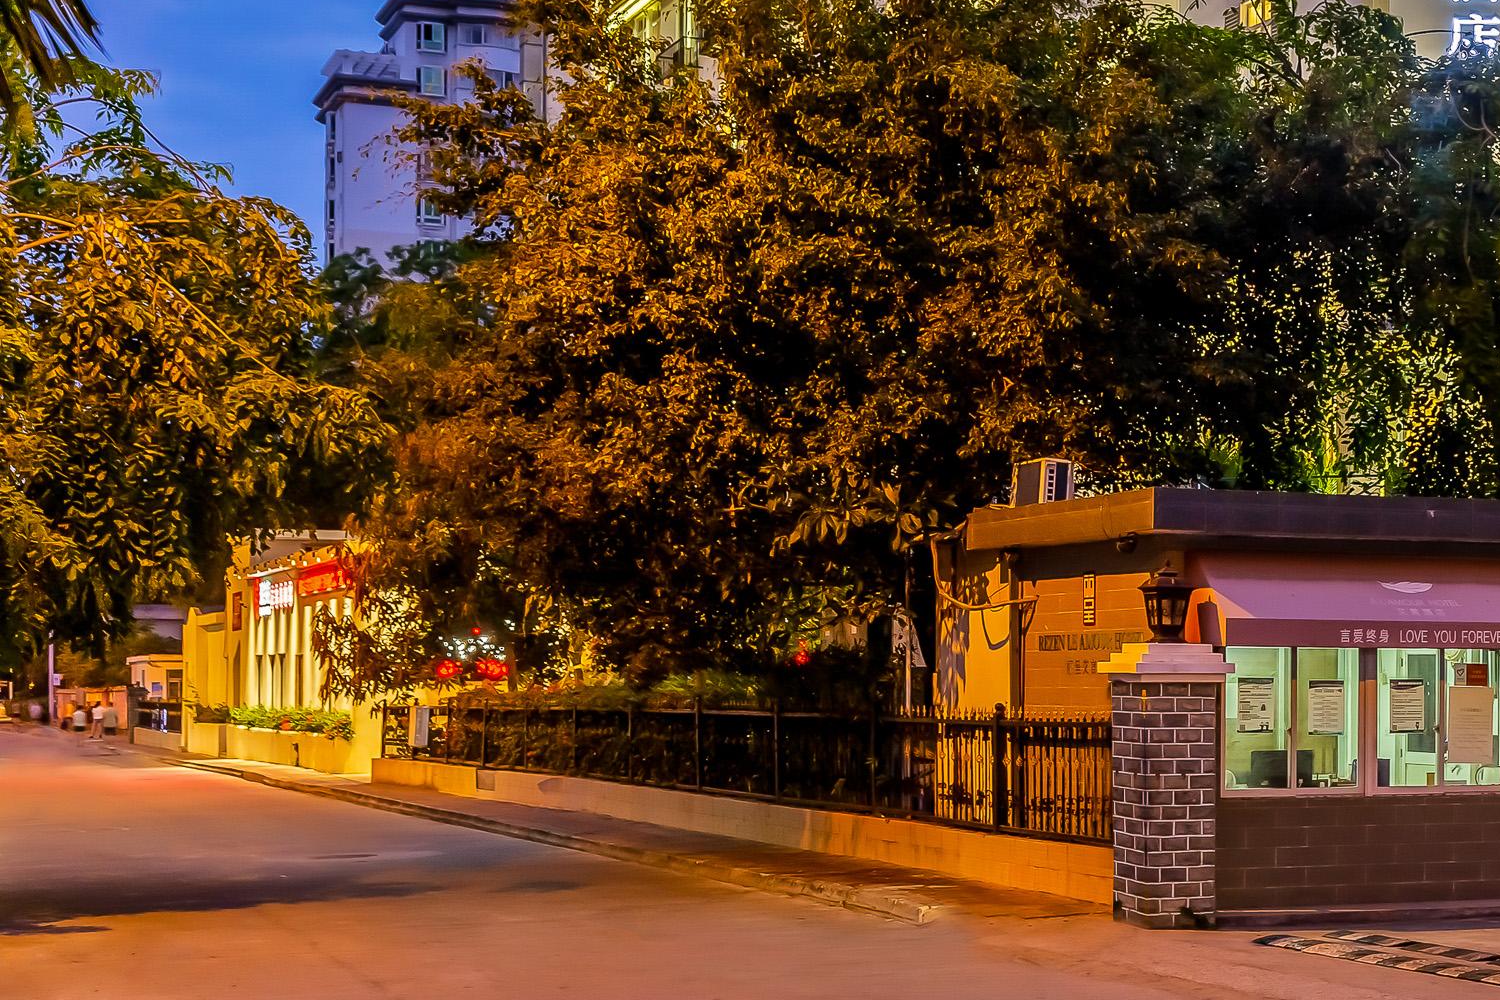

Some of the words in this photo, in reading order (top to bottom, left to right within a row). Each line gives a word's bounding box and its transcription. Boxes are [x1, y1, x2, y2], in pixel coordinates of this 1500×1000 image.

[1339, 628, 1390, 644] 言爱终身
[1400, 629, 1429, 644] LOVE
[1433, 630, 1457, 644] YOU
